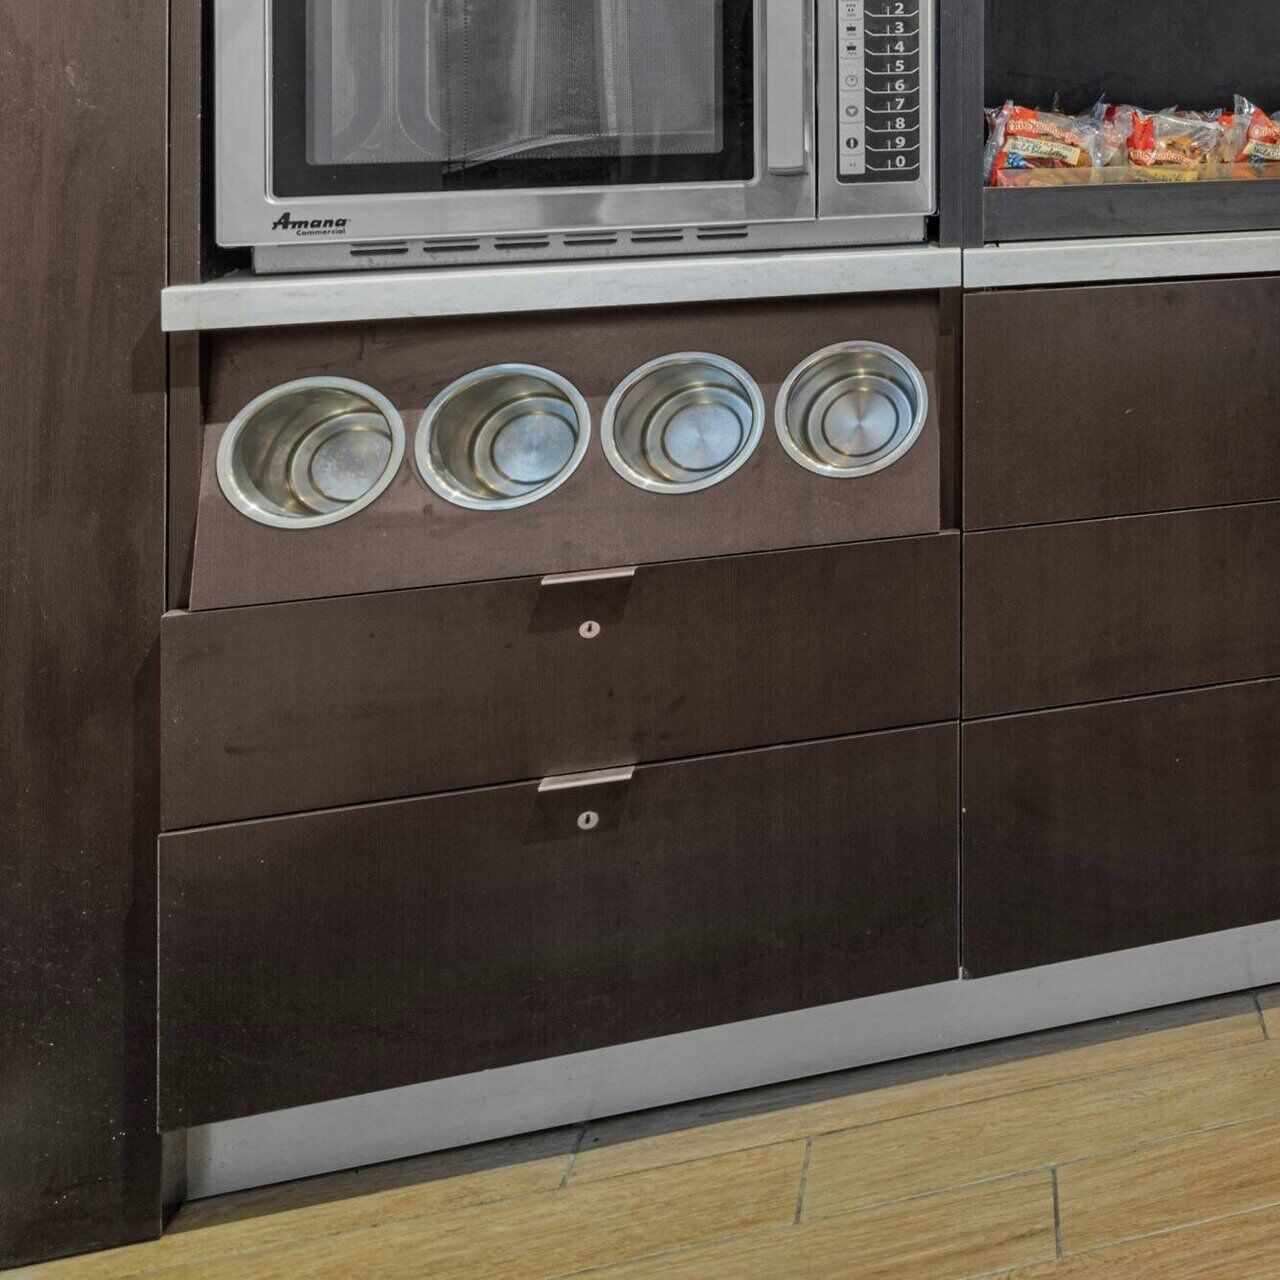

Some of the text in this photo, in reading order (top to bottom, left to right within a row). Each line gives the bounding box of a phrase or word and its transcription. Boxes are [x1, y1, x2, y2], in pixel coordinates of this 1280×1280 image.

[894, 2, 905, 15] 2
[894, 22, 905, 34] 3
[894, 41, 906, 53] 4
[895, 60, 905, 72] 5
[894, 79, 906, 91] 6
[895, 98, 905, 110] 7
[895, 117, 906, 130] 8
[895, 136, 906, 149] 9
[895, 155, 906, 168] 0
[272, 212, 347, 230] Amana
[296, 228, 346, 236] Commercial
